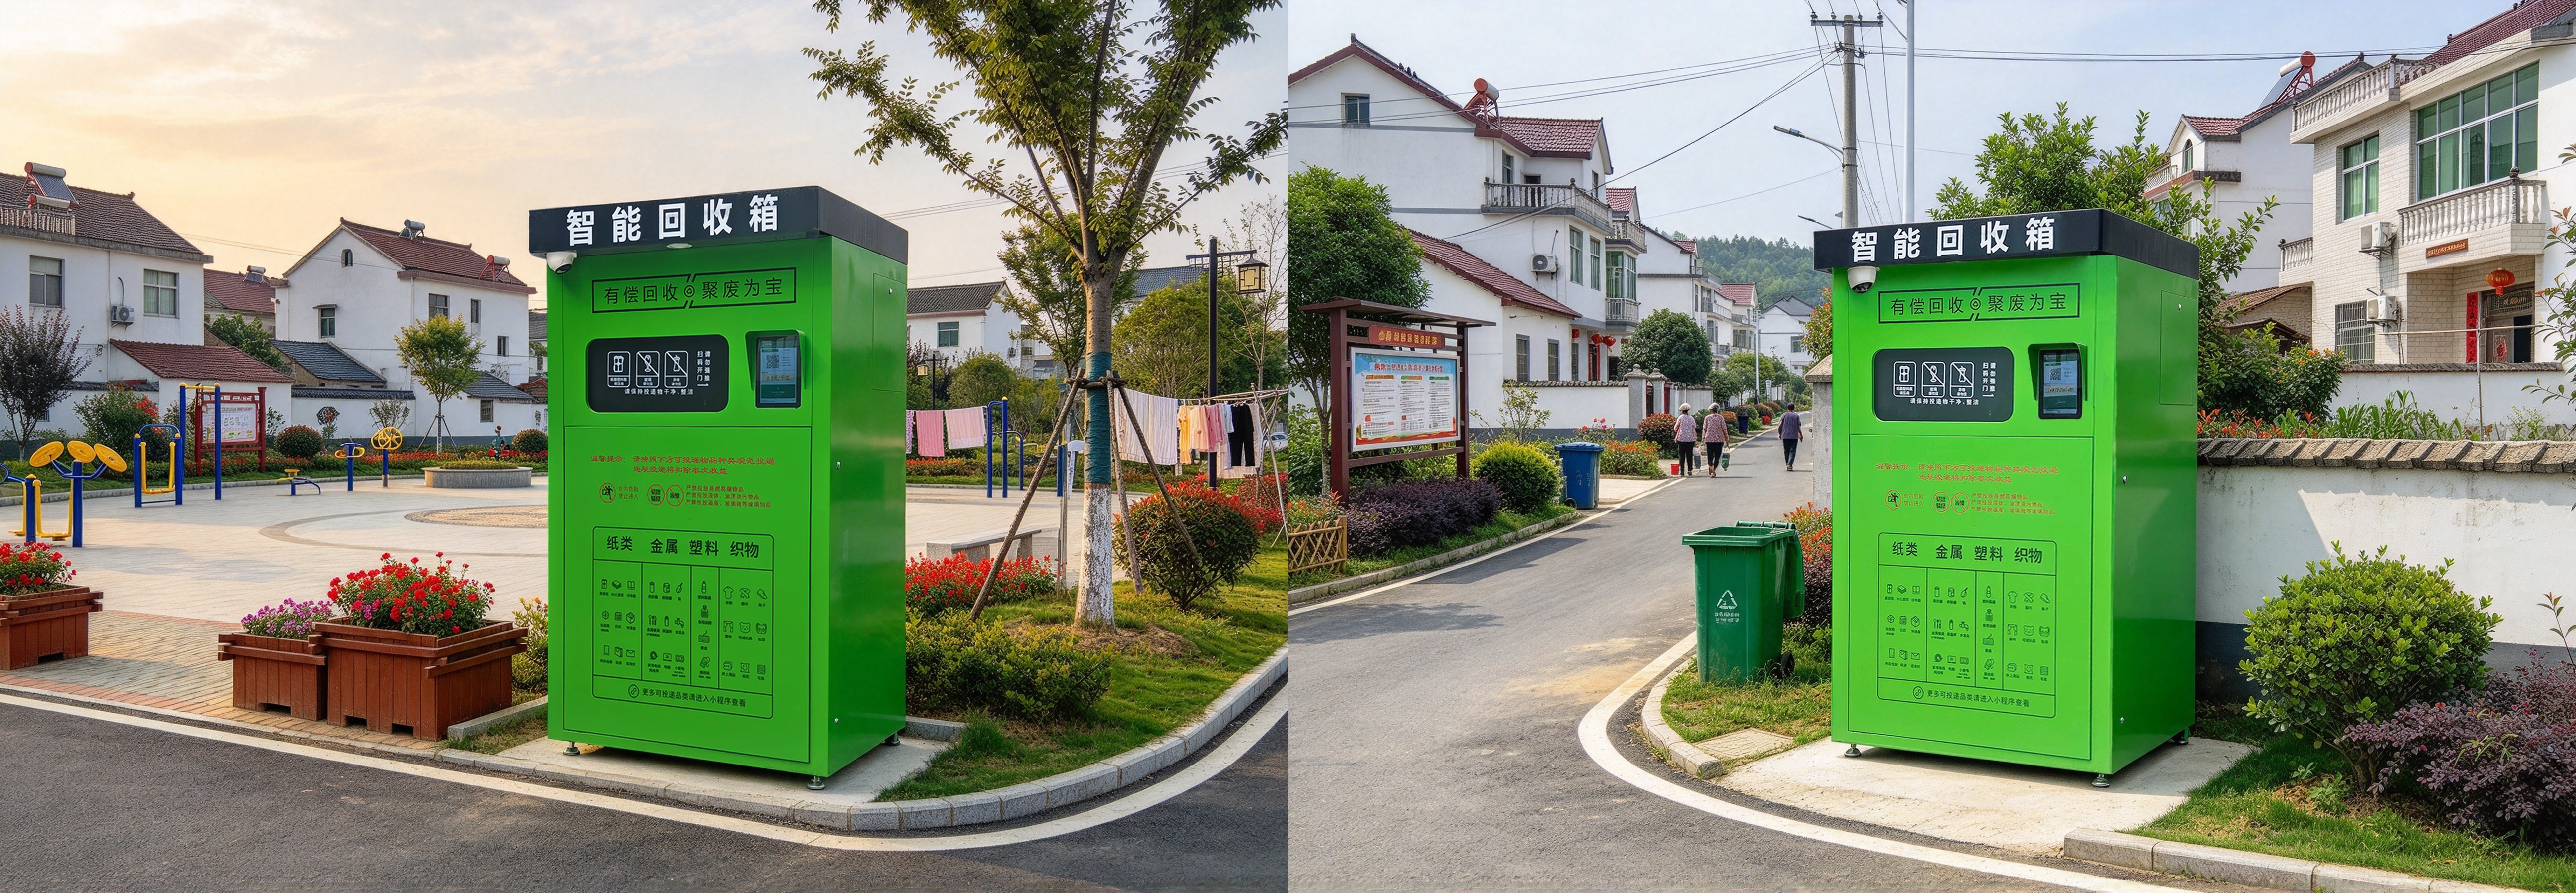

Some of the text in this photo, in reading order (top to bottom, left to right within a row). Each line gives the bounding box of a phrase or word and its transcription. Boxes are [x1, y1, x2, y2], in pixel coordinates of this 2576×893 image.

[566, 194, 778, 246] 智能回收箱
[1851, 217, 2055, 262] 智能回收箱
[604, 277, 782, 305] 有偿回收 聚废为宝
[1891, 292, 2066, 316] 有偿回收 聚废为宝
[633, 456, 775, 465] 请按照下方可投递物品种类规范投递
[633, 466, 727, 475] 违规投递将扣除本次收益
[607, 536, 759, 558] 纸类 金属 塑料 织物
[1892, 542, 2042, 563] 纸类 金属 塑料 织物
[642, 688, 746, 707] 更多可投递品类请进入小程序查看
[1927, 690, 2030, 707] 更多可投递品类请进入小程序查看
